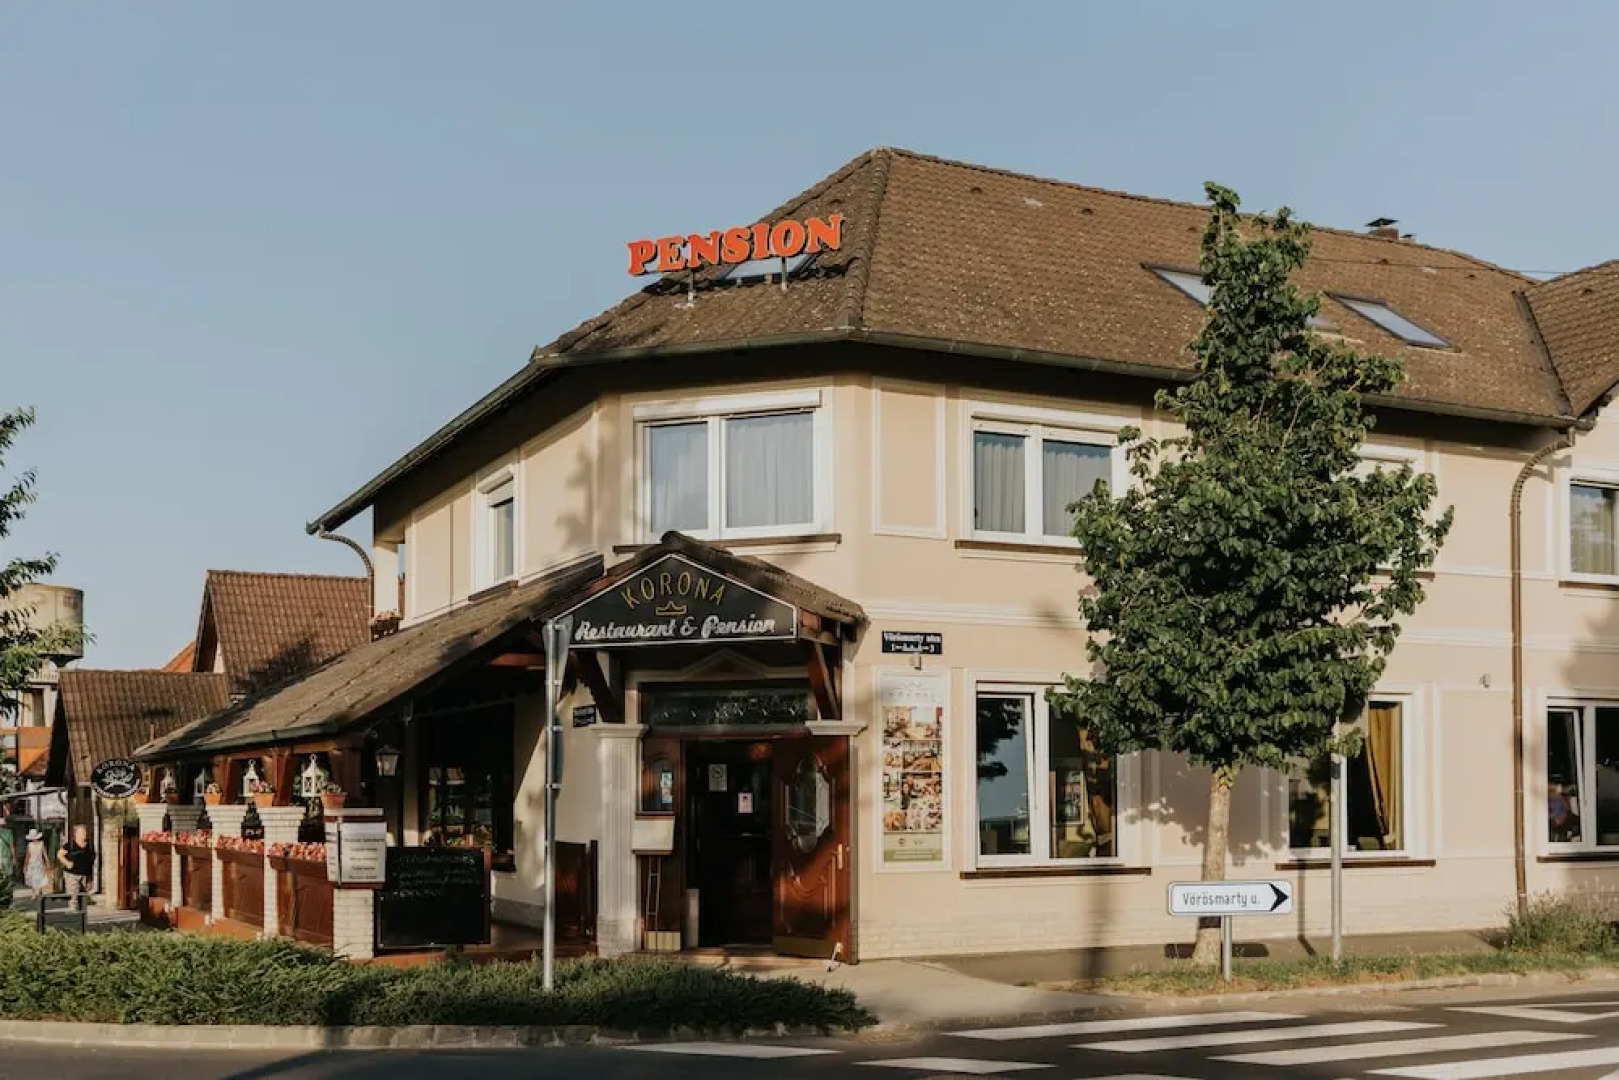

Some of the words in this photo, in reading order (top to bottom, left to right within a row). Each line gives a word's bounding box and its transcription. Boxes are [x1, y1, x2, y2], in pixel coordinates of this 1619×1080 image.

[628, 213, 844, 276] PENSION
[621, 571, 726, 610] KORONA
[574, 617, 676, 642] Restaurant
[679, 616, 698, 637] &
[701, 612, 776, 640] Pension
[1183, 892, 1247, 907] Vörösmarty
[1251, 895, 1261, 904] u.
